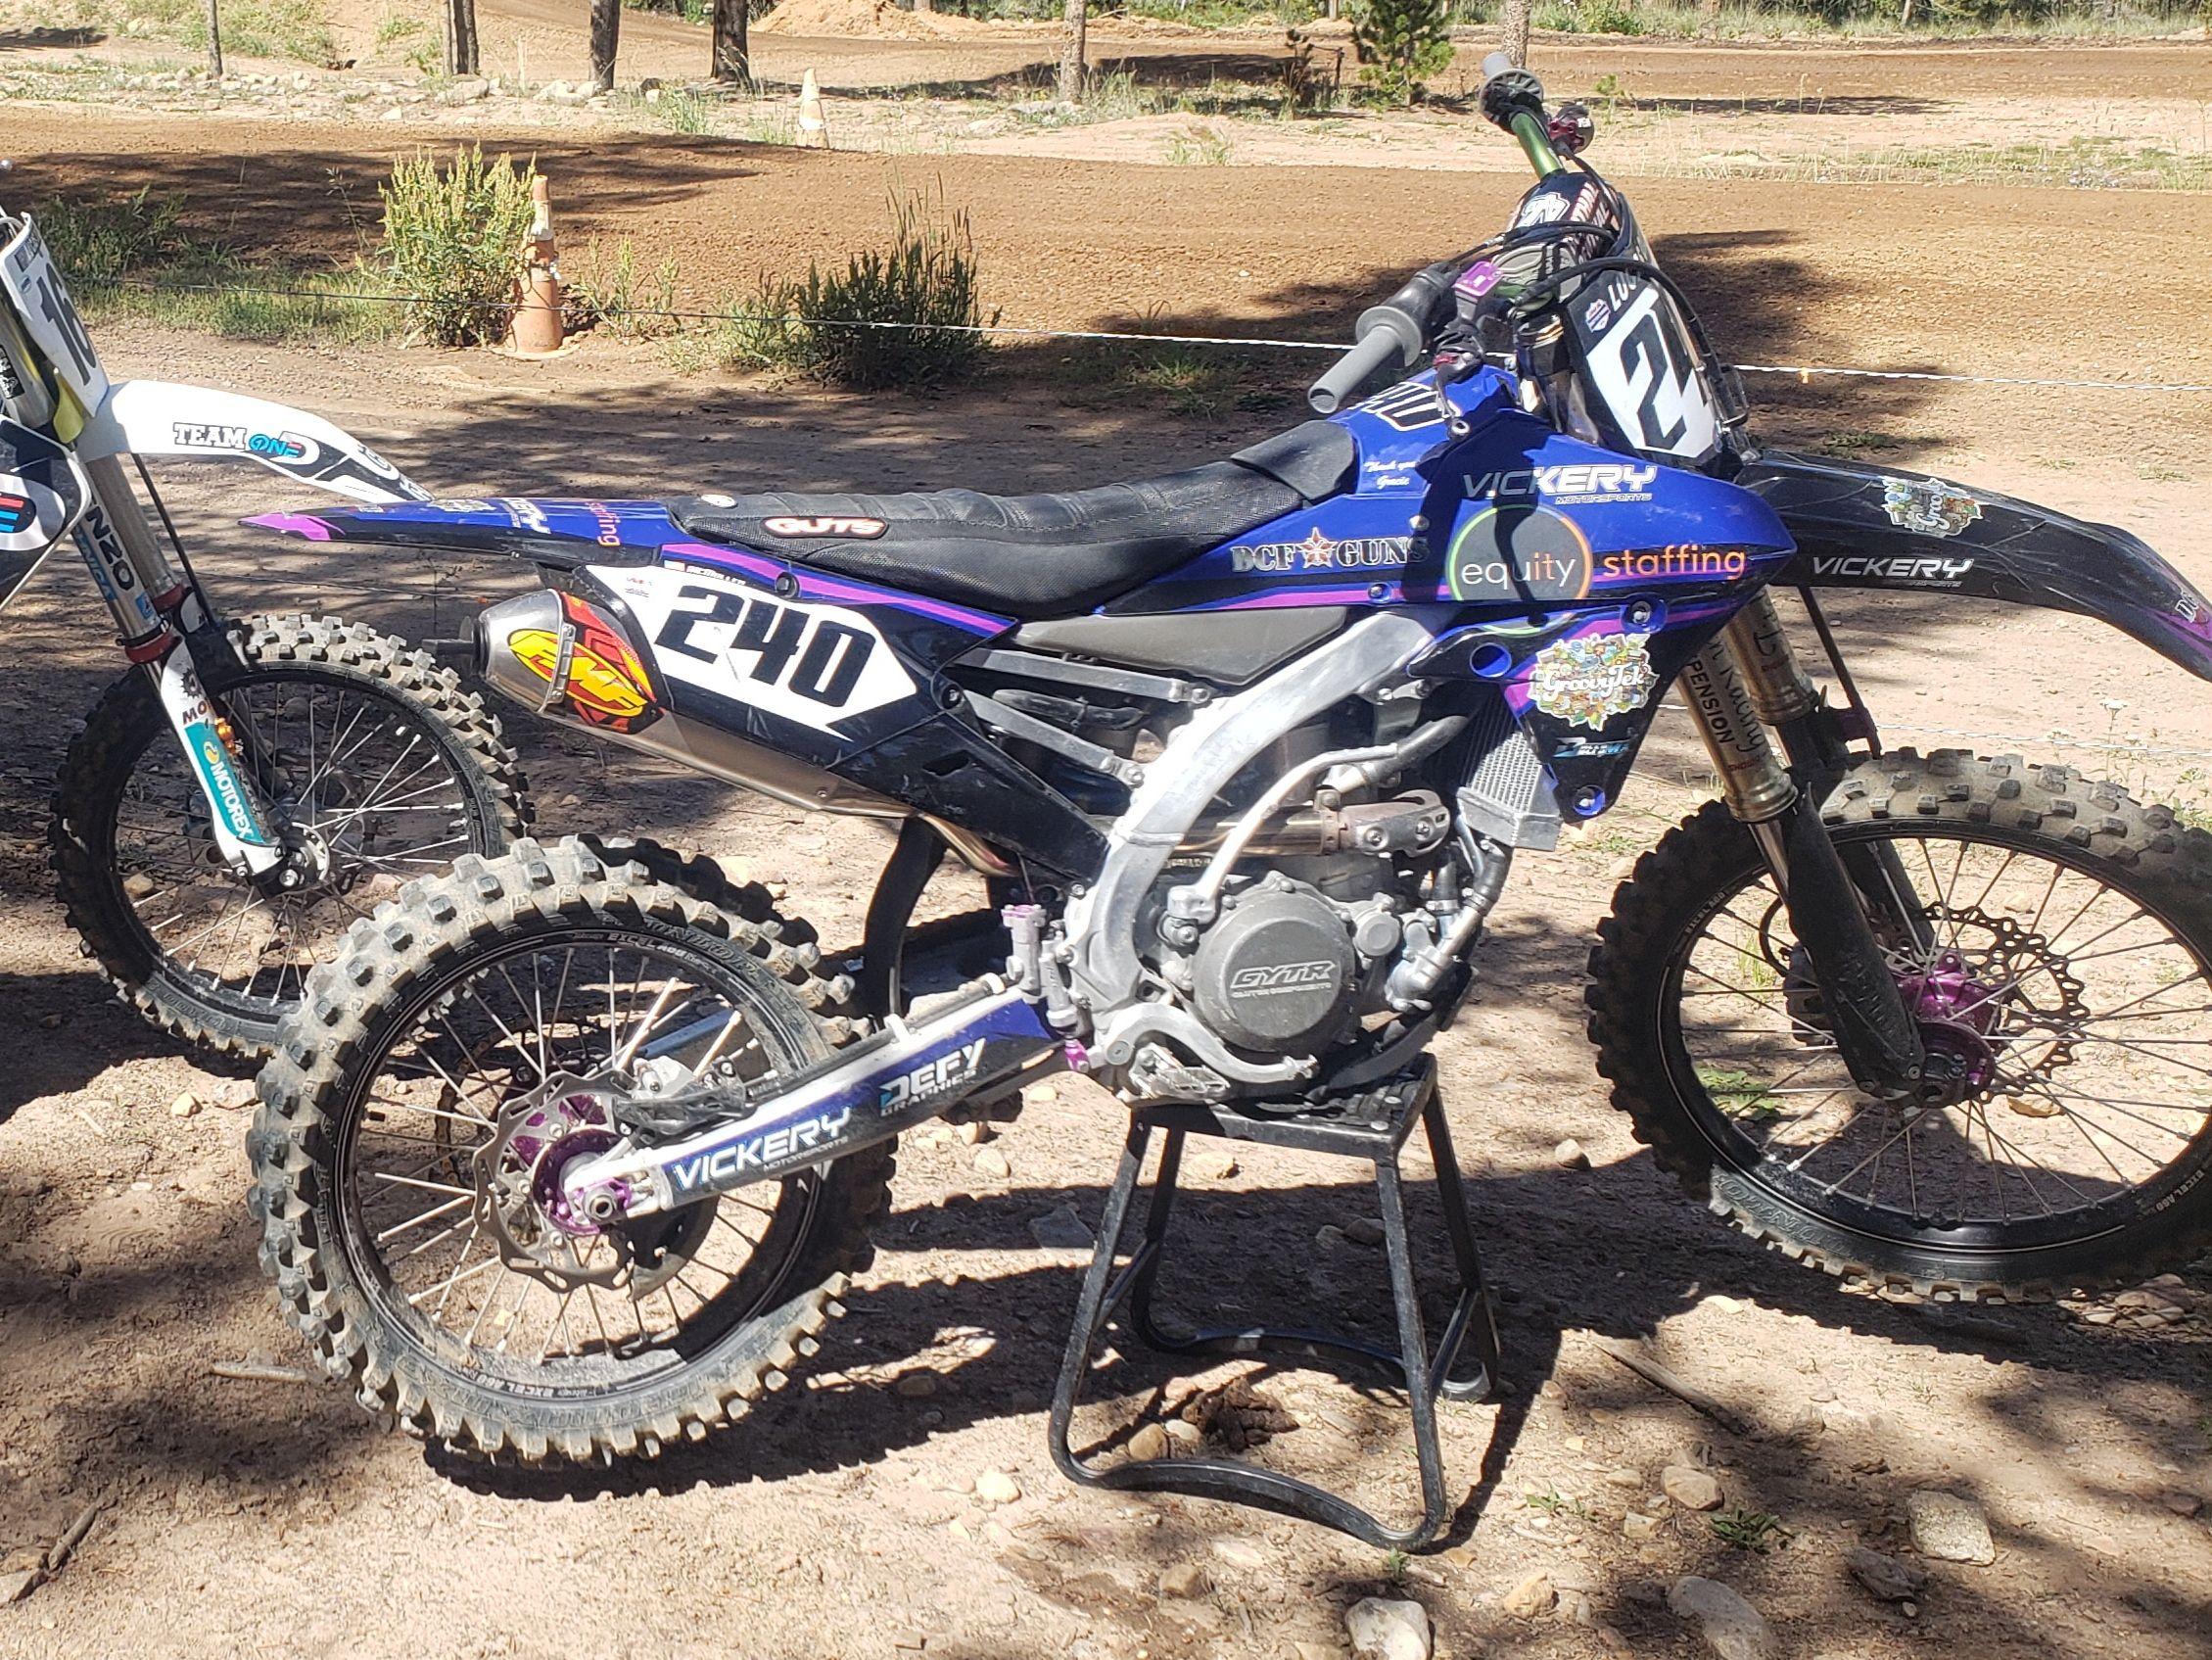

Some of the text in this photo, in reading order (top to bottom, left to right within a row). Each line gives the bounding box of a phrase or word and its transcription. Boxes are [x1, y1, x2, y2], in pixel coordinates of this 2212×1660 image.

[173, 422, 300, 458] TEAM ONE
[1462, 463, 1658, 498] VICKERY
[84, 494, 135, 591] NZO
[764, 517, 886, 535] GUTS
[1336, 537, 1431, 567] GUNS
[1461, 545, 1747, 590] equity staffing
[1812, 556, 1975, 580] VICKERY
[654, 585, 876, 707] 240
[1688, 656, 1735, 743] PENSION
[211, 761, 255, 838] MOTOREX
[1230, 961, 1336, 988] GYTR
[879, 1038, 986, 1110] DEFY
[673, 1106, 852, 1191] VICKERY
